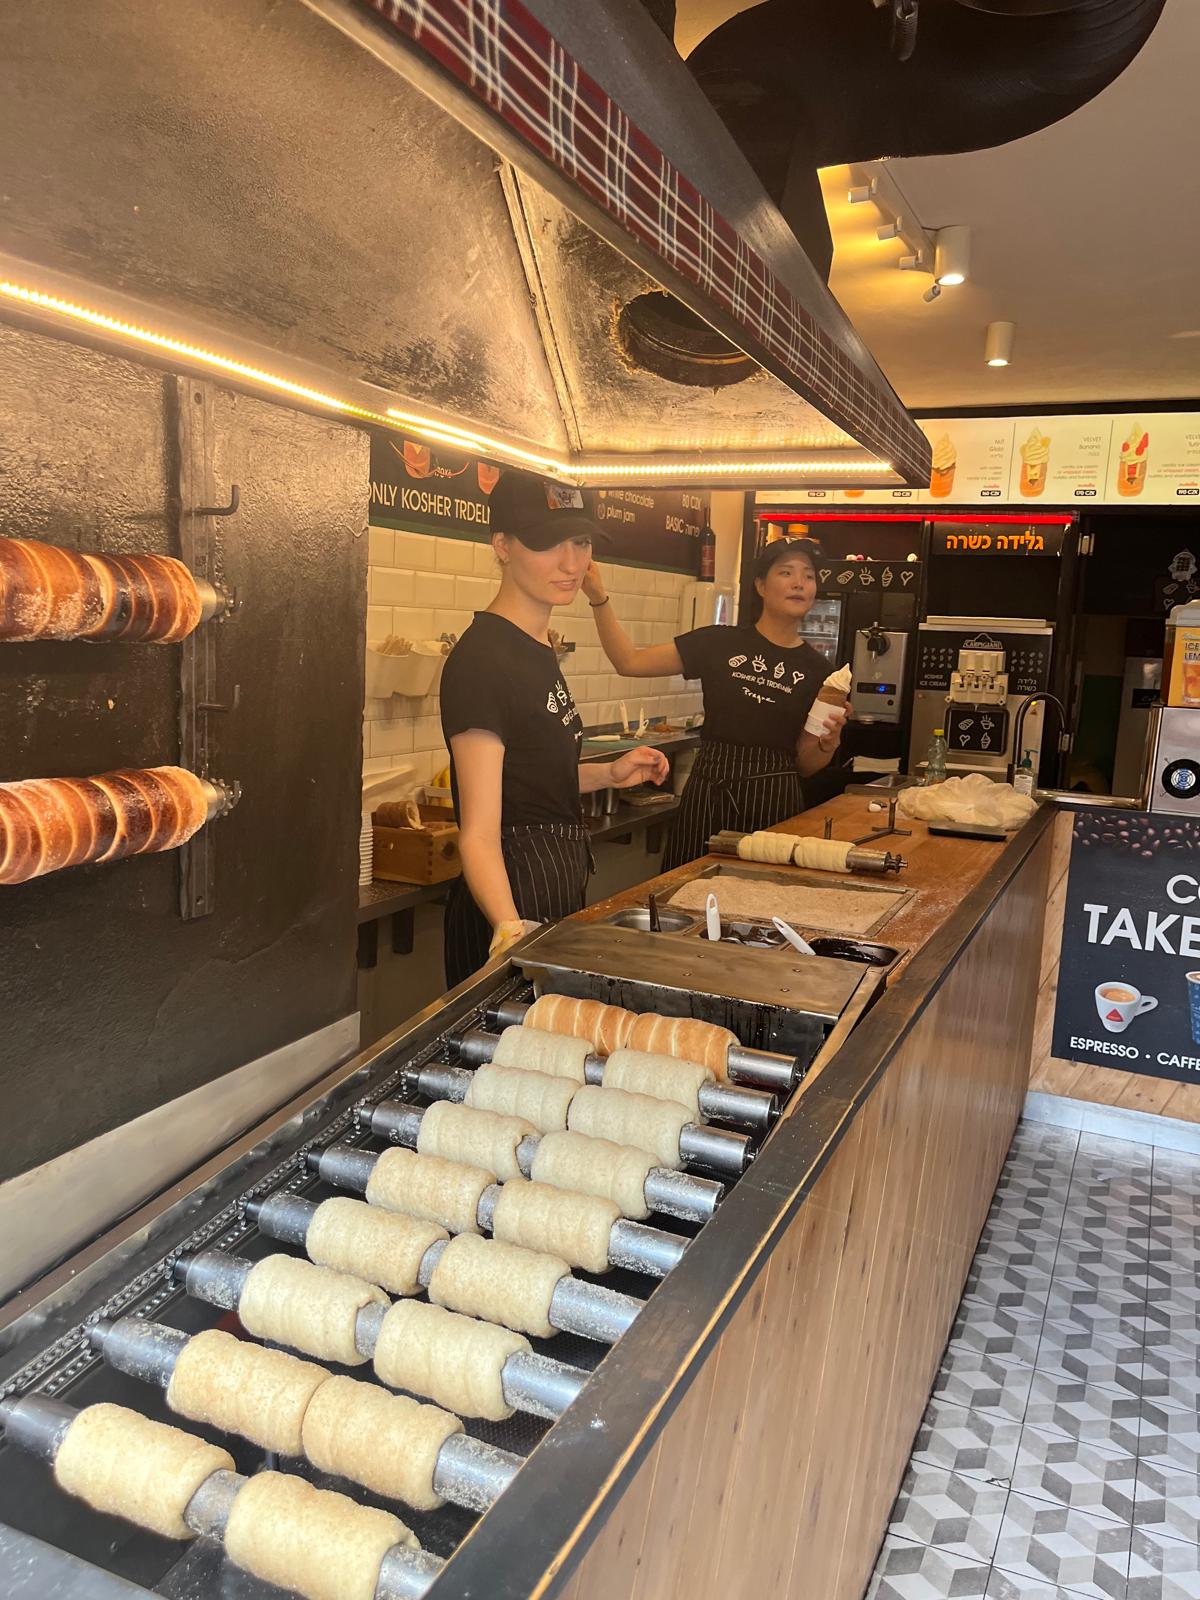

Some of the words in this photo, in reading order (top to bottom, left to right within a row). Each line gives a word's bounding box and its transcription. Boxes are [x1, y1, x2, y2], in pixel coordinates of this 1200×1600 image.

[401, 487, 451, 517] KOSHER
[625, 490, 654, 508] chocolate
[606, 505, 622, 519] plum
[623, 508, 635, 523] jam
[665, 514, 684, 534] BASIC
[946, 535, 992, 549] כשרה
[996, 530, 1044, 550] גלידה
[732, 671, 756, 682] KOSHER
[1166, 874, 1200, 904] C
[1083, 903, 1200, 959] TAKE
[1070, 1036, 1139, 1059] ESPRESSO
